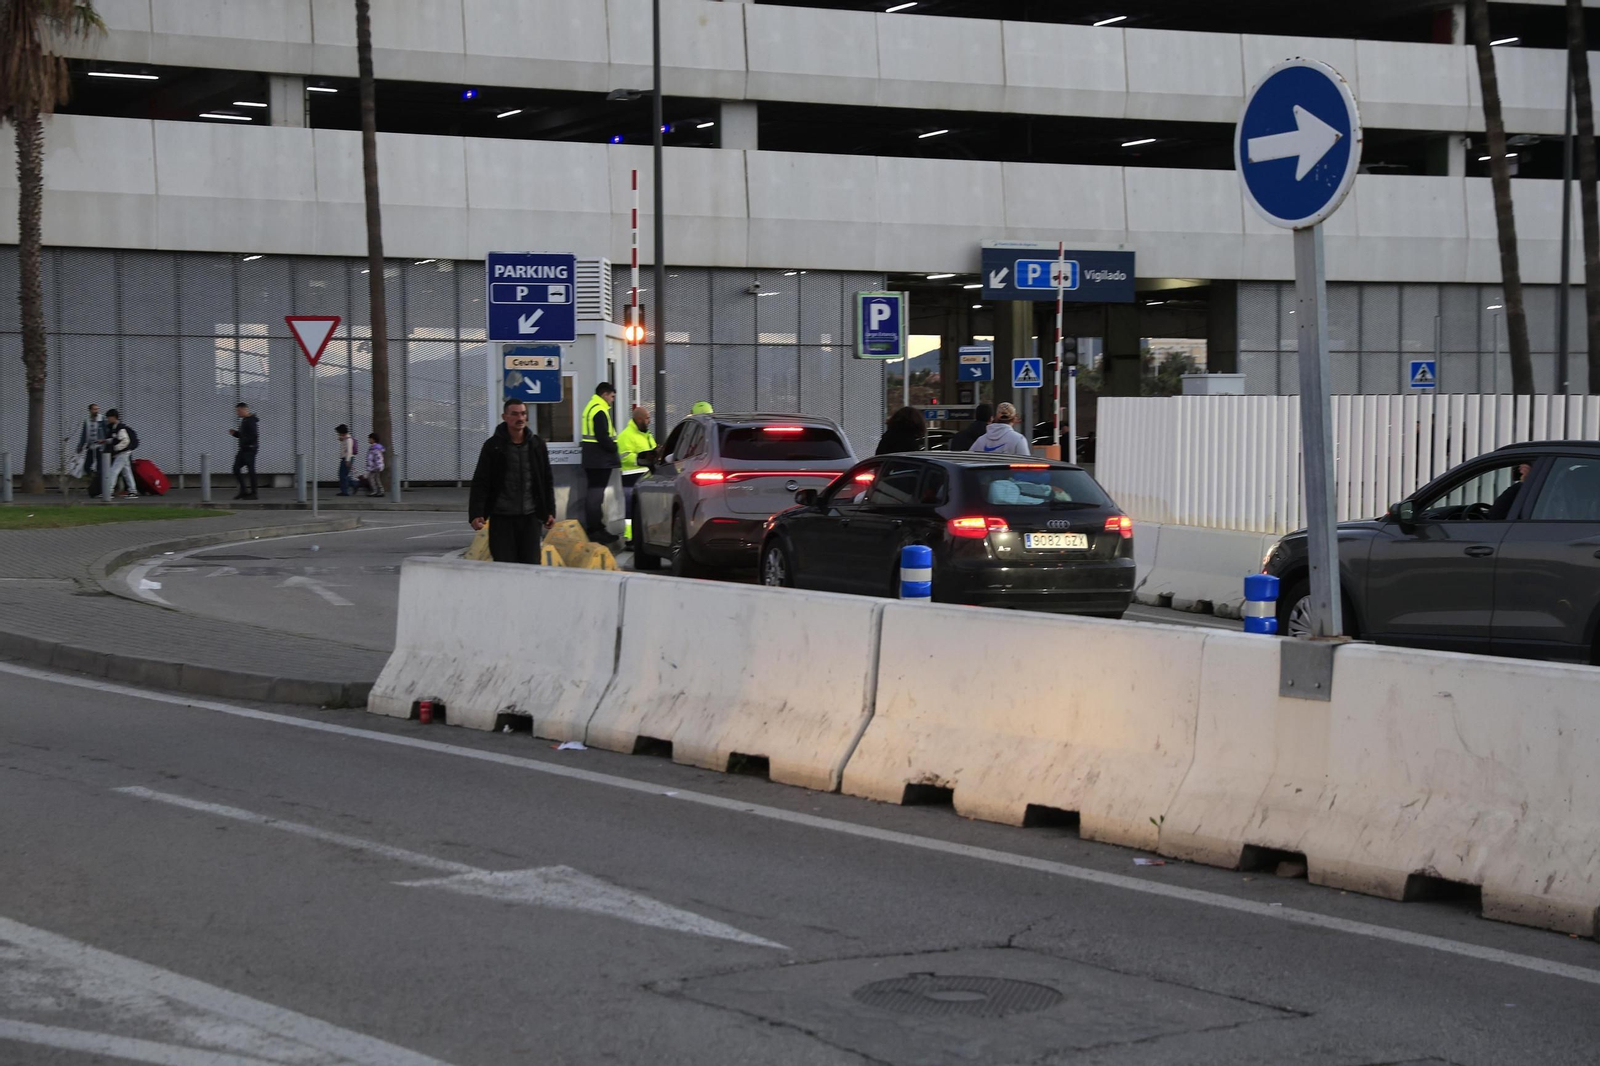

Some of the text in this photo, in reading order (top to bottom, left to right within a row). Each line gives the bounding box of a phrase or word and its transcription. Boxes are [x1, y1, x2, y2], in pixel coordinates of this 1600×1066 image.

[494, 264, 569, 279] PARKING
[1027, 263, 1127, 285] P Vigilado
[516, 286, 529, 301] P
[870, 303, 891, 330] P
[512, 358, 539, 366] Ceuta
[1033, 535, 1085, 547] 9082 GZX
